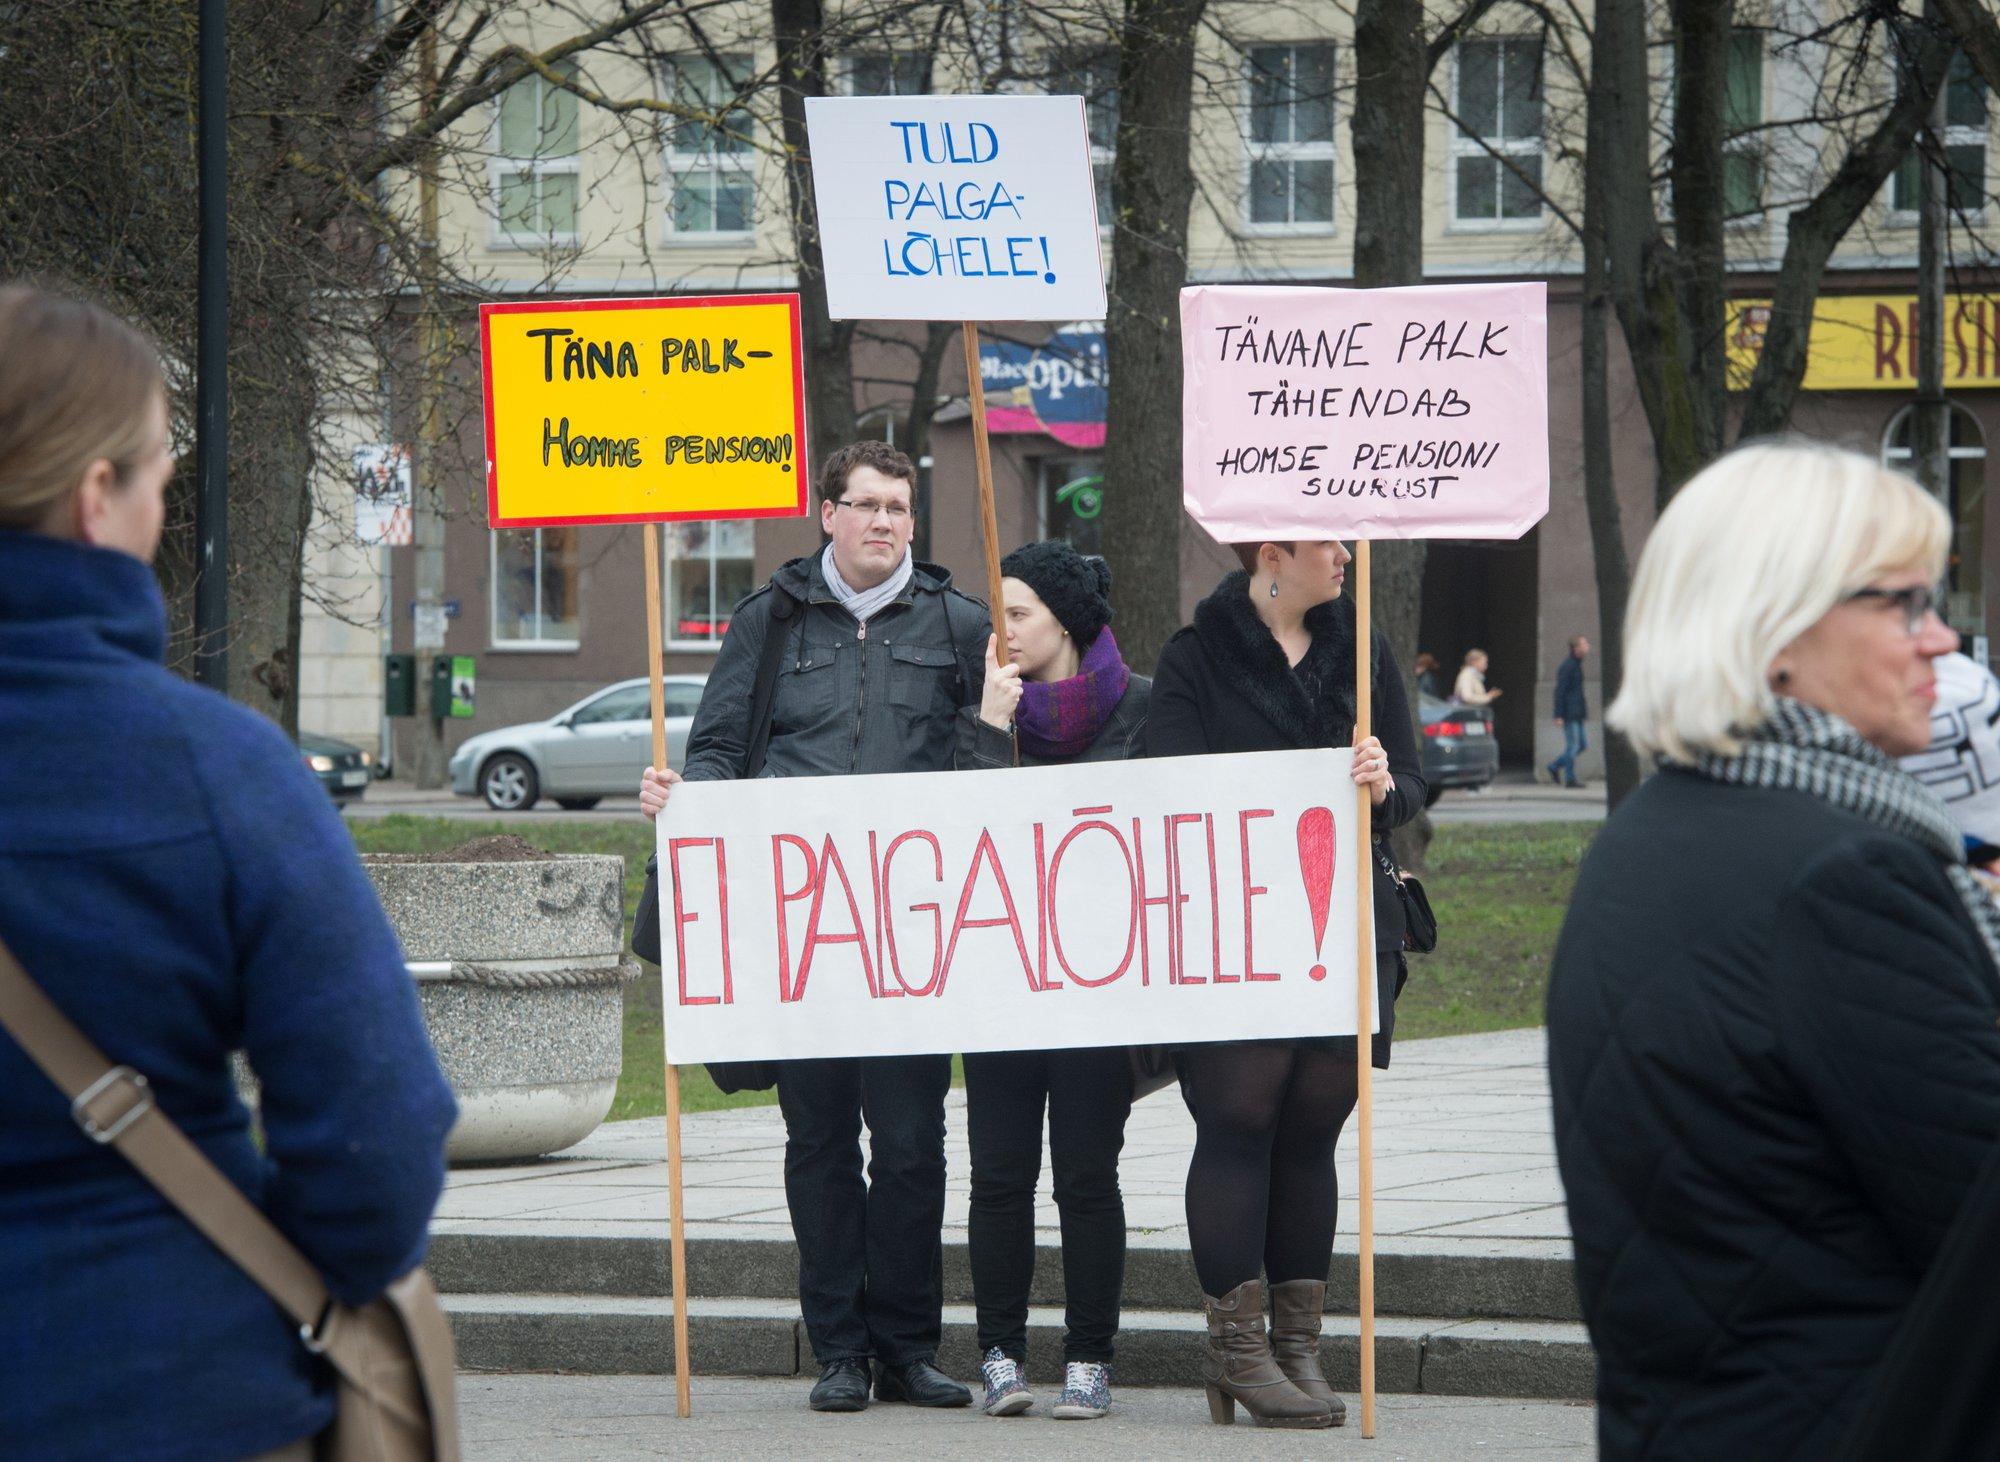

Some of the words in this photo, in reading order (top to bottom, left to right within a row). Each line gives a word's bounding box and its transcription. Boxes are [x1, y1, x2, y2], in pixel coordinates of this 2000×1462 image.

[889, 120, 999, 165] TULD
[884, 178, 1025, 222] PALGA-
[884, 231, 1057, 285] LÕHELE!
[527, 329, 639, 382] TÄNA
[1215, 315, 1373, 369] TÄNANE
[1397, 321, 1509, 363] PALK
[1248, 380, 1471, 418] TÄHENDAB
[543, 417, 643, 468] HOMME
[666, 434, 793, 473] PENSION!
[1217, 446, 1328, 475] HOMSE
[1302, 476, 1459, 500] SUURUST
[669, 838, 734, 1006] EI
[772, 804, 1336, 1002] PALGALÕHELE!
